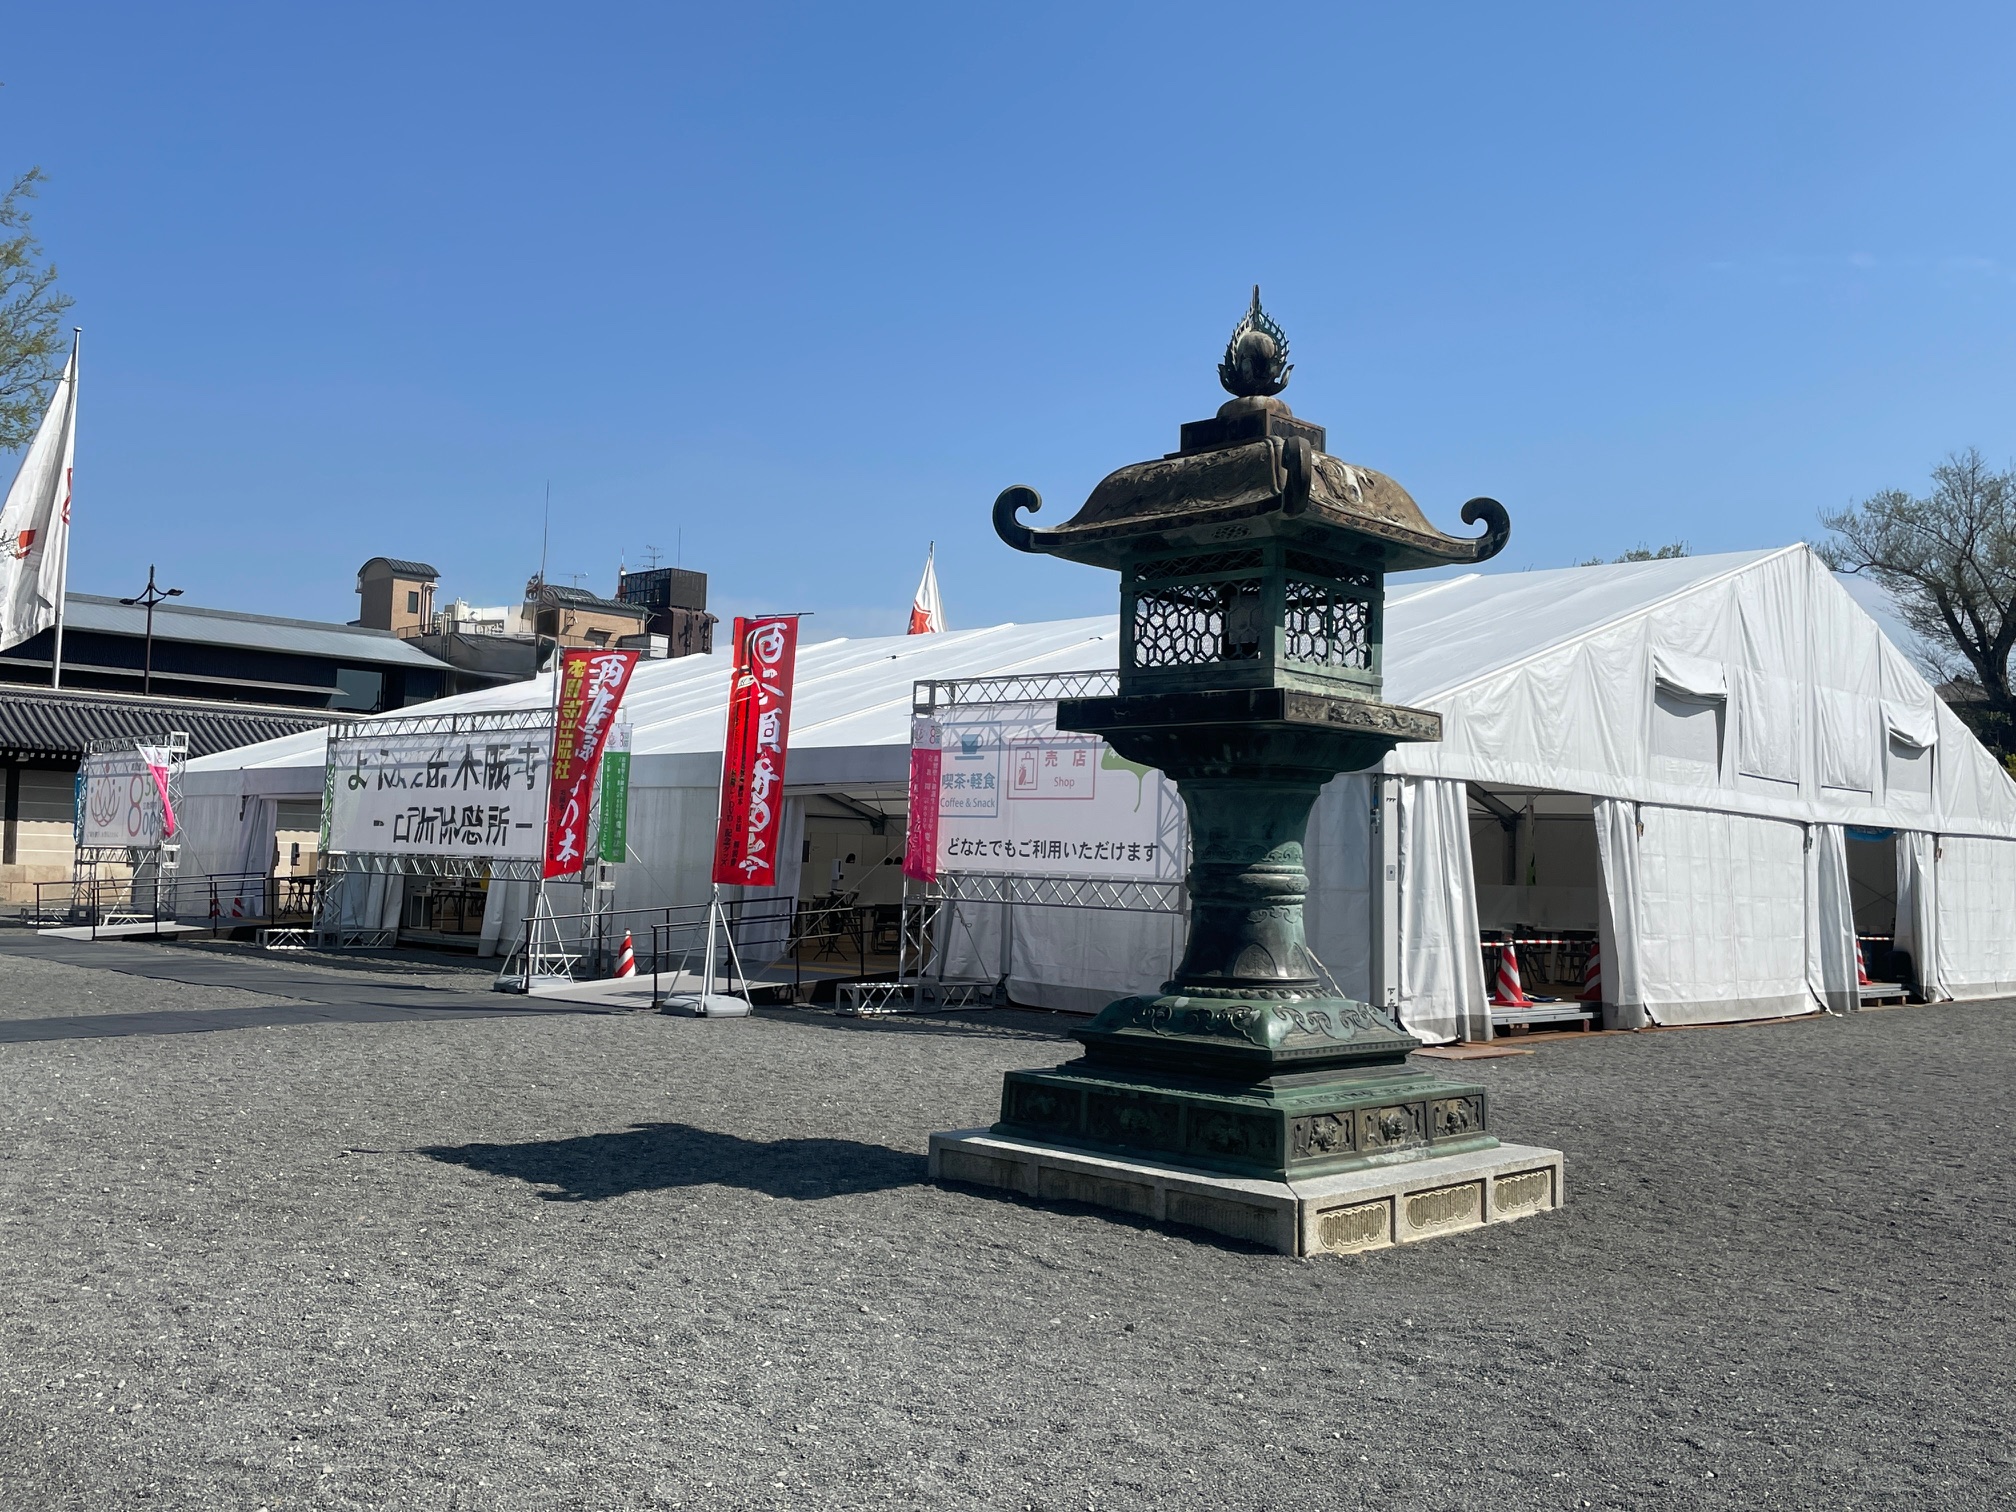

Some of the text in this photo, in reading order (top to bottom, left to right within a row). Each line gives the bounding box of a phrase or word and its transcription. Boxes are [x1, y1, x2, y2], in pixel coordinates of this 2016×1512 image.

[942, 772, 996, 791] 喫茶・軽食
[1053, 776, 1075, 788] Shop
[940, 797, 996, 808] Coffee & Snack
[947, 837, 1159, 862] どなたでもご利用いただけます
